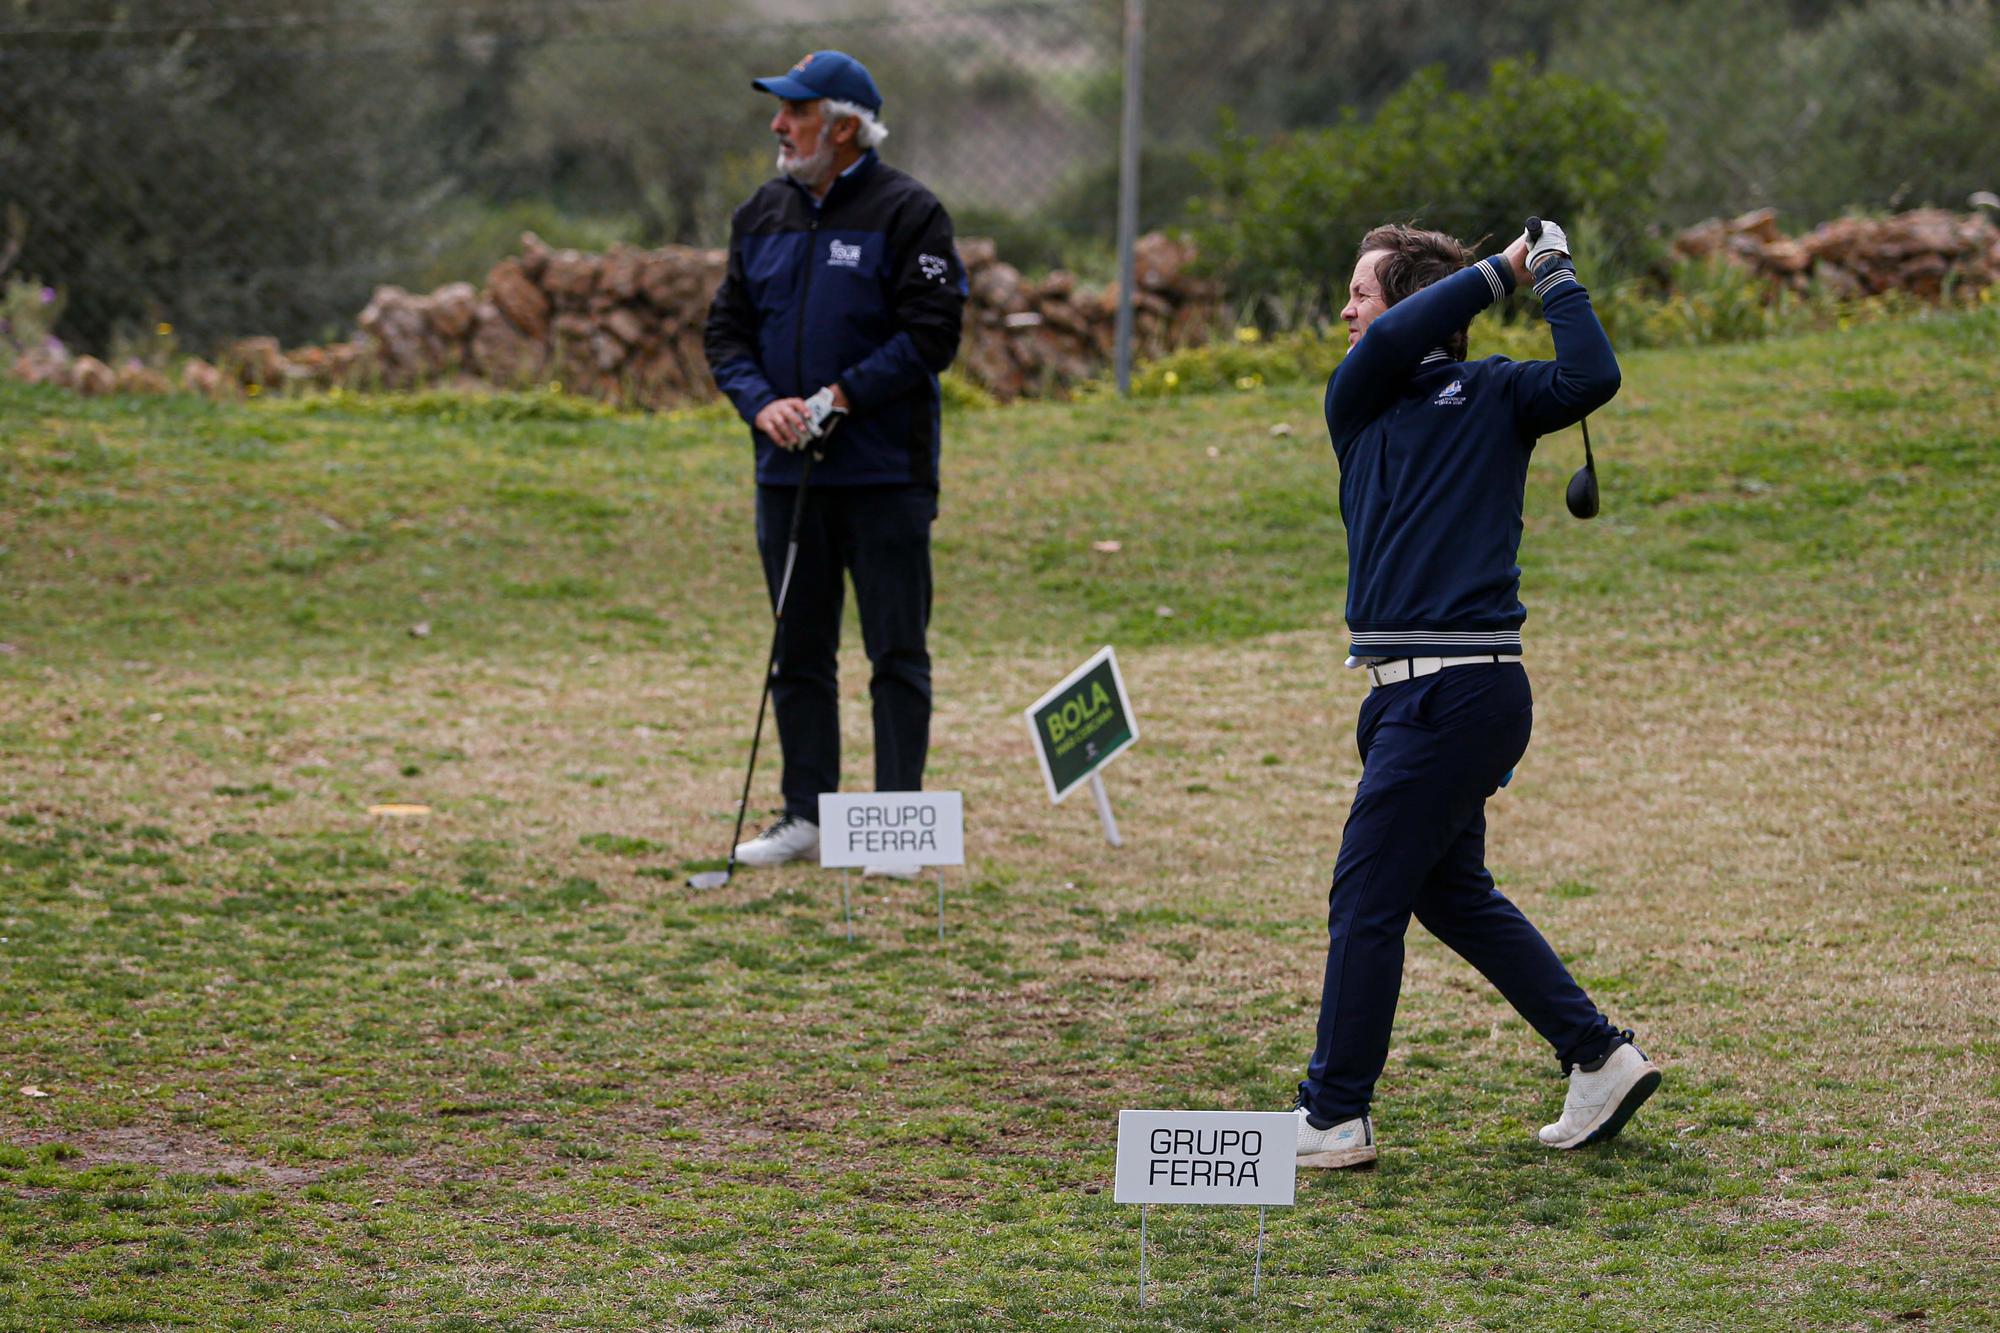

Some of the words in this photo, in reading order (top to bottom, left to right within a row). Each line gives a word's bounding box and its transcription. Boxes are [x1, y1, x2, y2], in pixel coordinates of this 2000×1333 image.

[1046, 681, 1111, 744] BOLA
[847, 805, 936, 828] GRUPO
[848, 828, 937, 852] FERRÁ
[1150, 1128, 1262, 1156] GRUPO
[1149, 1158, 1260, 1187] FERRÁ
